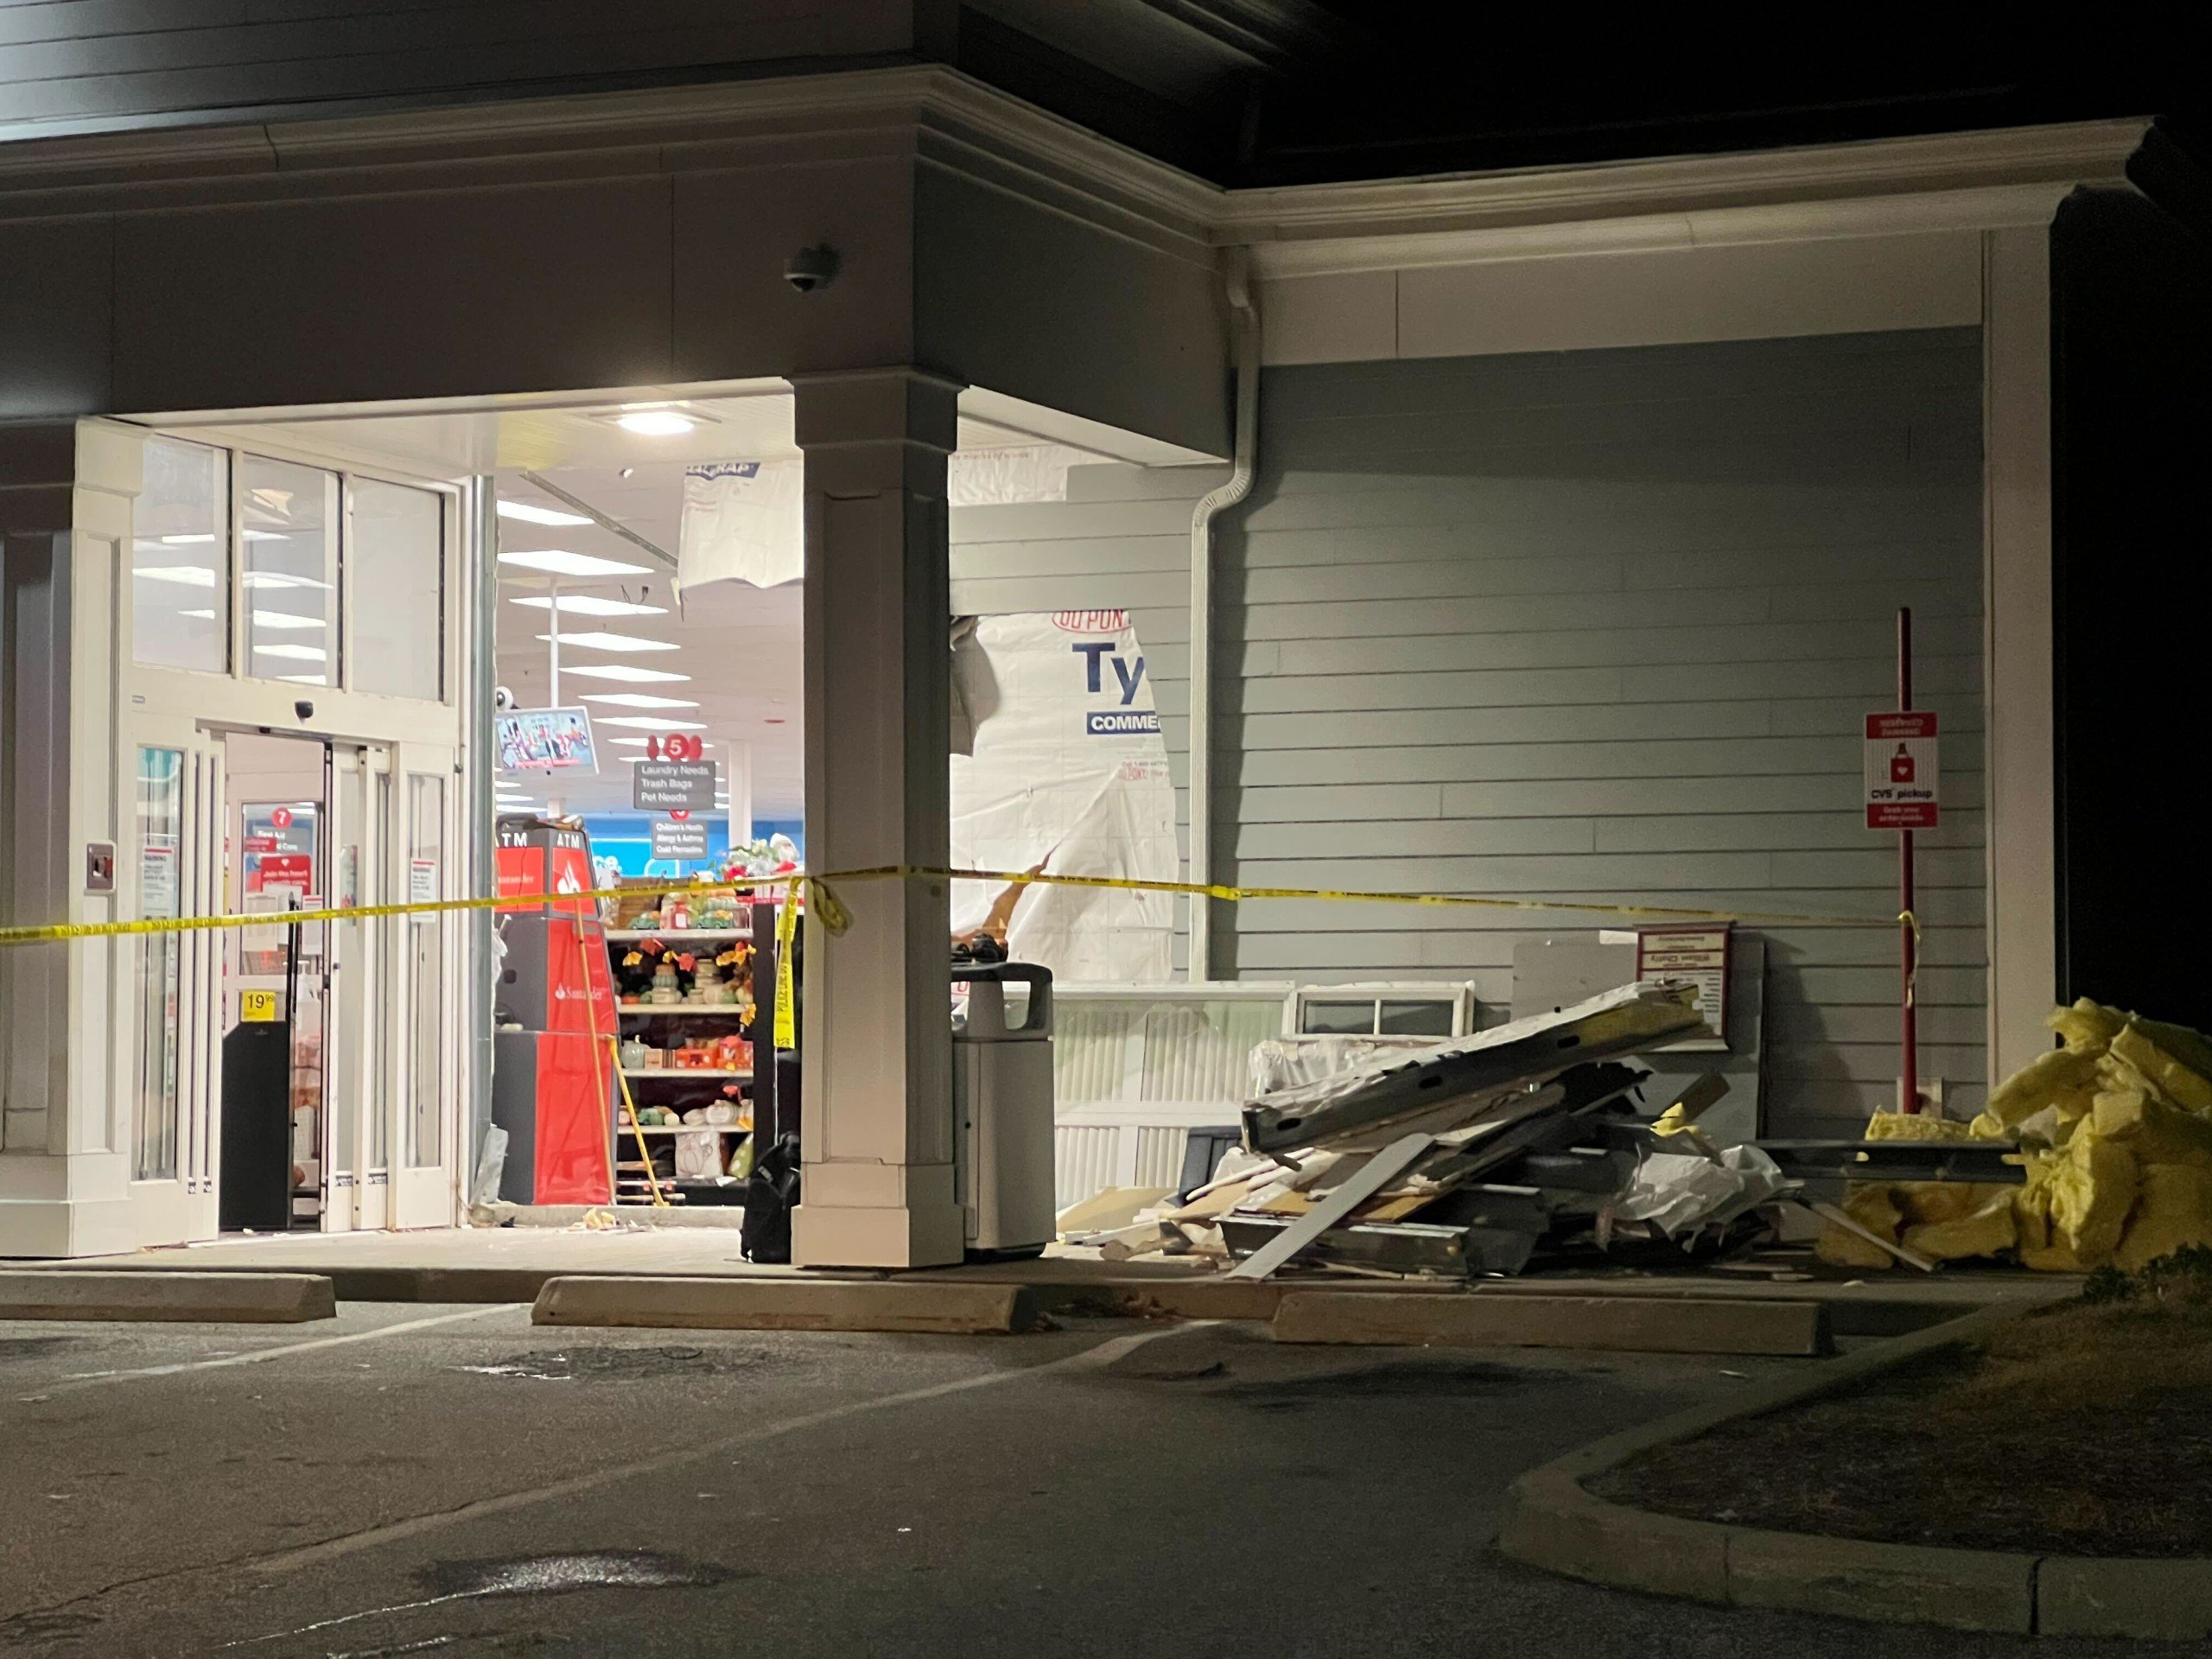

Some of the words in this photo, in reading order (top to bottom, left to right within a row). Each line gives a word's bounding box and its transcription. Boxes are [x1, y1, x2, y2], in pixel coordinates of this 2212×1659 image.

[1072, 643, 1145, 705] Ty
[669, 740, 683, 755] 5
[641, 766, 677, 776] Laundry
[680, 766, 709, 775] Needs
[641, 779, 667, 787] Trash
[670, 779, 693, 789] Bags
[641, 792, 657, 802] Pet
[658, 793, 688, 802] Needs
[1871, 790, 1892, 798] CVS
[1897, 790, 1933, 799] pickup
[277, 811, 287, 824] 7
[495, 832, 528, 847] TM
[556, 833, 580, 849] ATM
[247, 994, 264, 1009] 19
